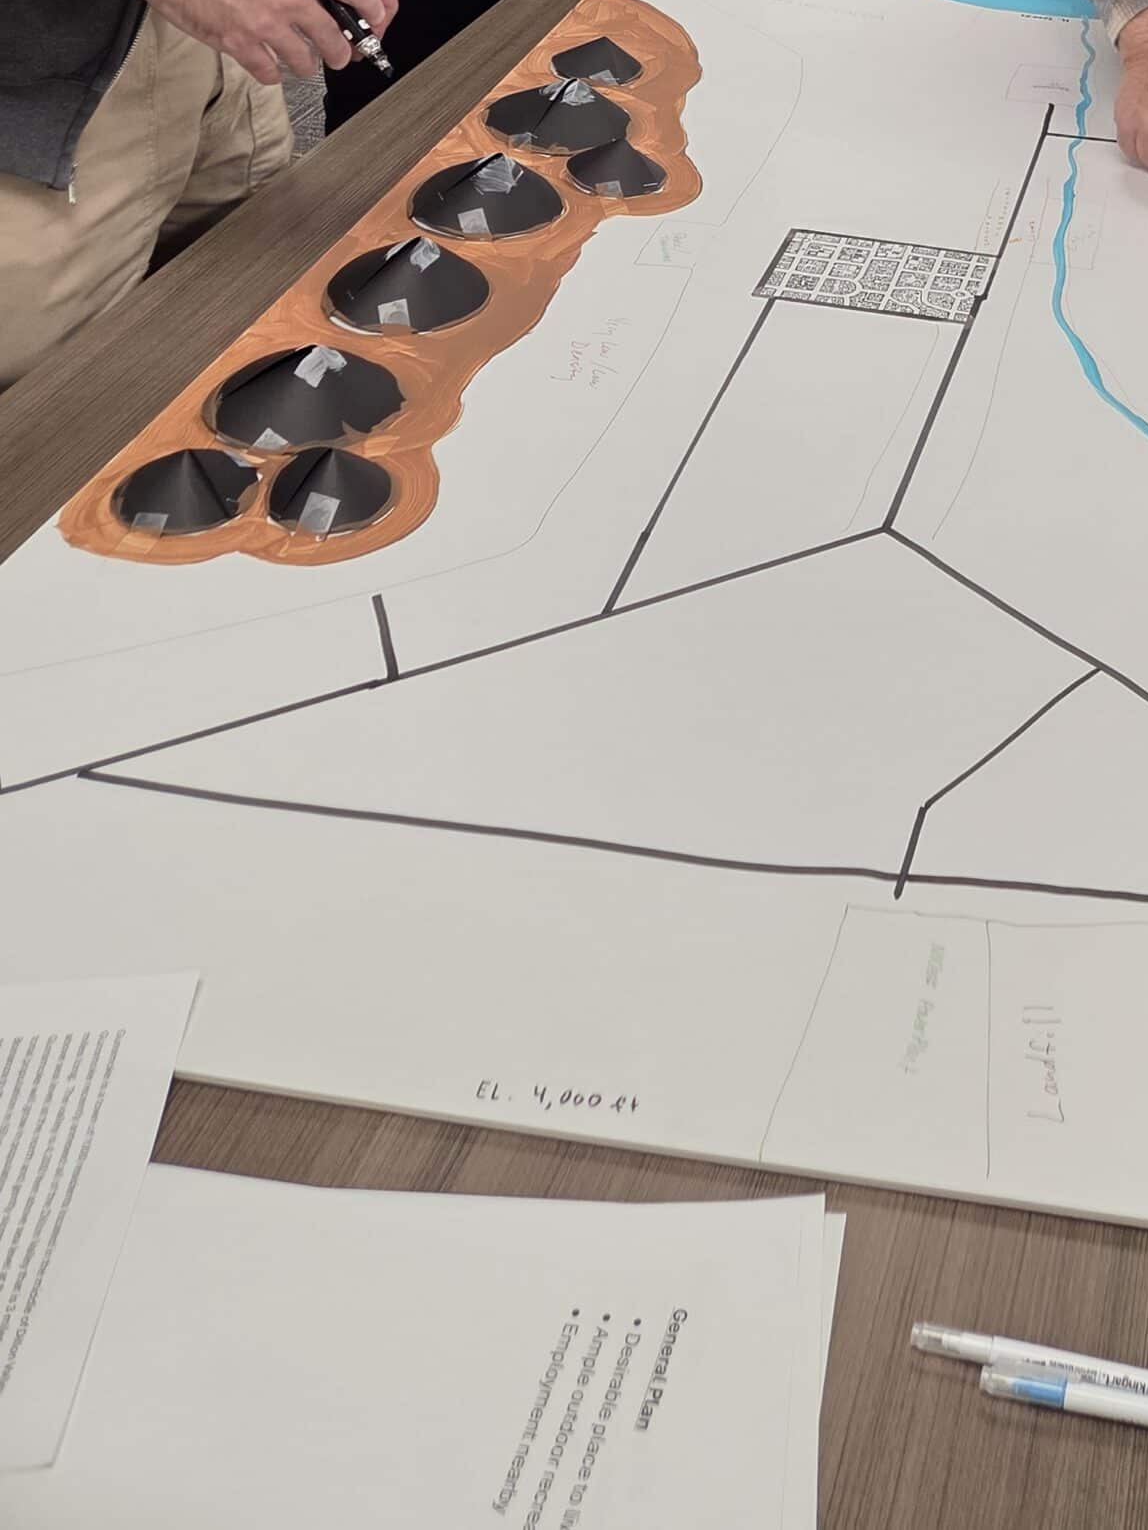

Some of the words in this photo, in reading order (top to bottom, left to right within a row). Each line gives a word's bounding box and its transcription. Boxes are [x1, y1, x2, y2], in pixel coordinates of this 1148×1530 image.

[533, 1085, 602, 1111] 4,000
[577, 1325, 609, 1387] Ample
[599, 1331, 641, 1421] Desirable
[653, 1308, 688, 1384] General
[522, 1322, 579, 1442] Employment
[633, 1387, 664, 1433] Plan
[548, 1389, 584, 1469] outdoor
[578, 1421, 606, 1482] place
[492, 1443, 529, 1516] nearby
[569, 1484, 588, 1505] to
